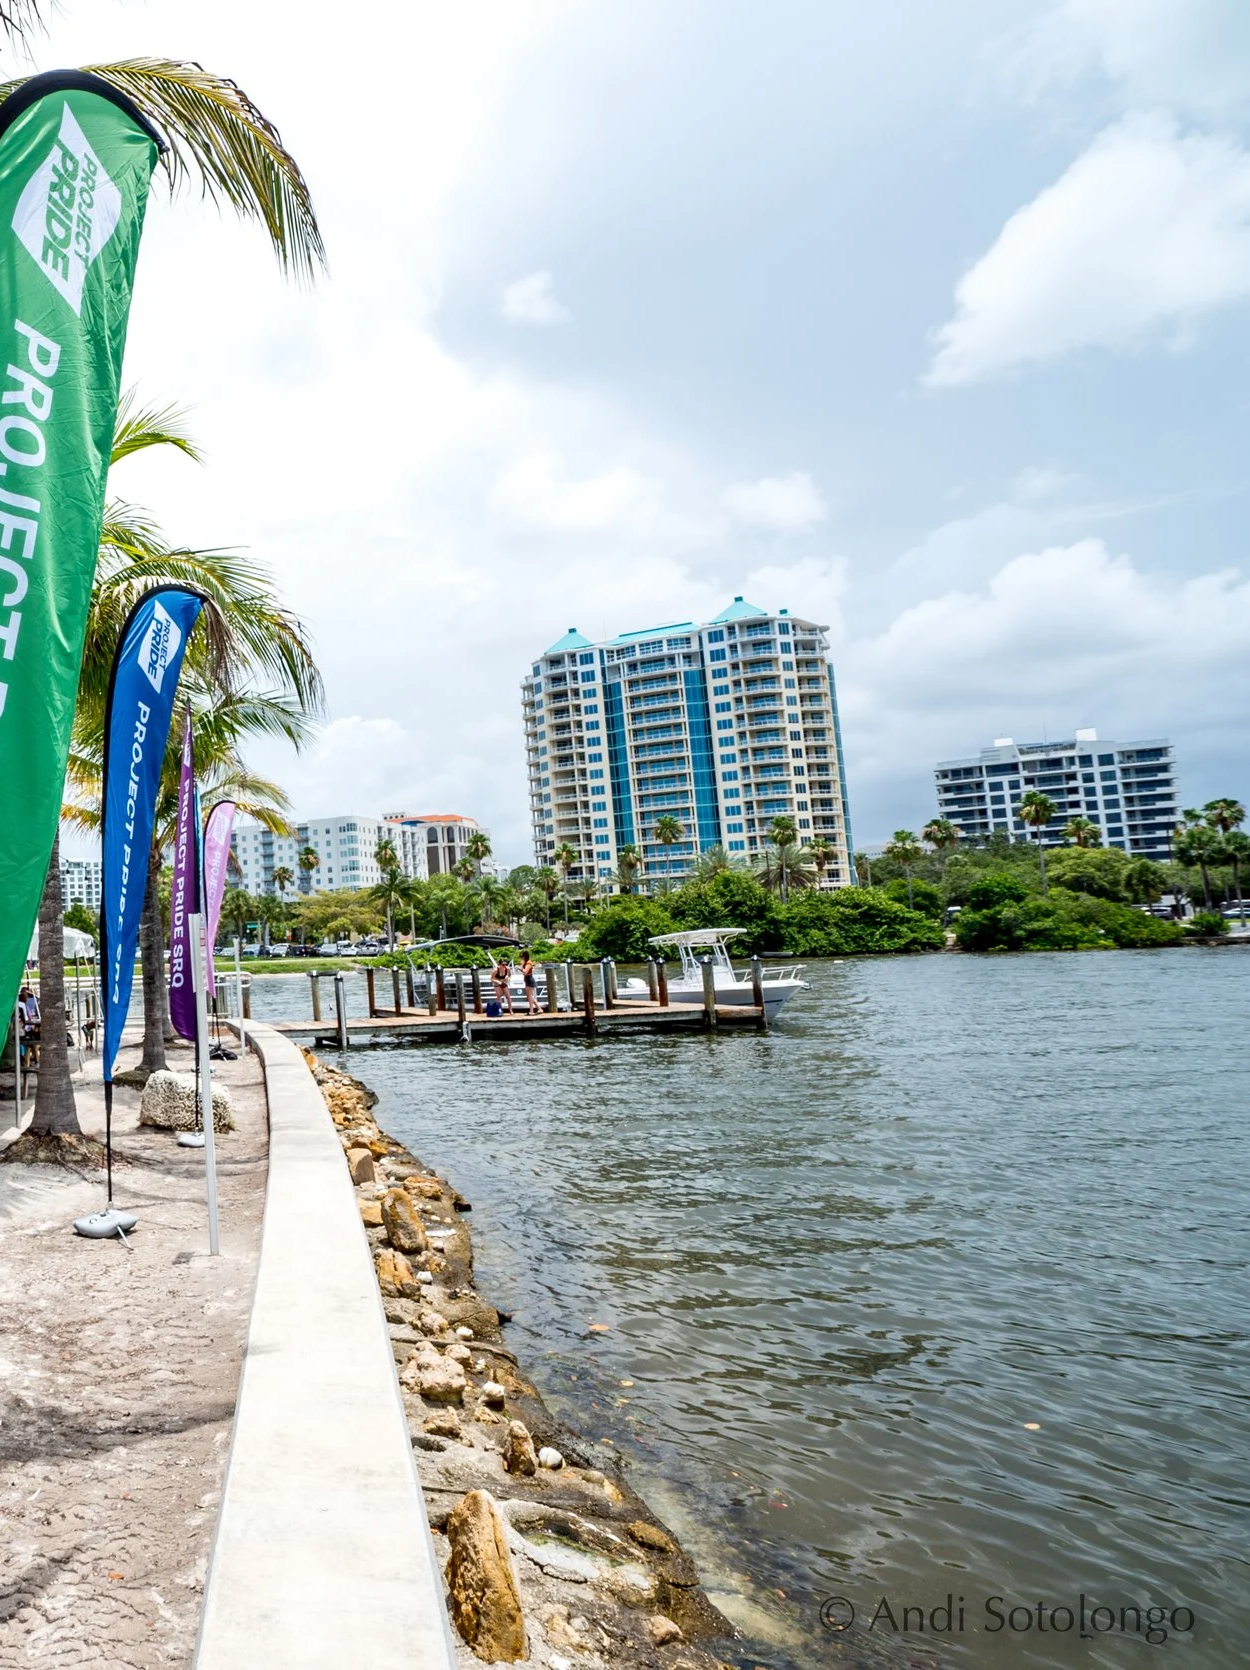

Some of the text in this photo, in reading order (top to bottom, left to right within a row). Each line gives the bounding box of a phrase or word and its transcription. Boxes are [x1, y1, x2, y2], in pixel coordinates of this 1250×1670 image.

[42, 141, 79, 282] PRIDE
[74, 152, 99, 271] PROJECT
[147, 616, 163, 679] PRIDE
[159, 618, 171, 672] PROJECT
[125, 701, 150, 840] PROJECT
[171, 778, 190, 988] PROJECT PRIDE SRQ
[207, 851, 221, 906] PROJECT
